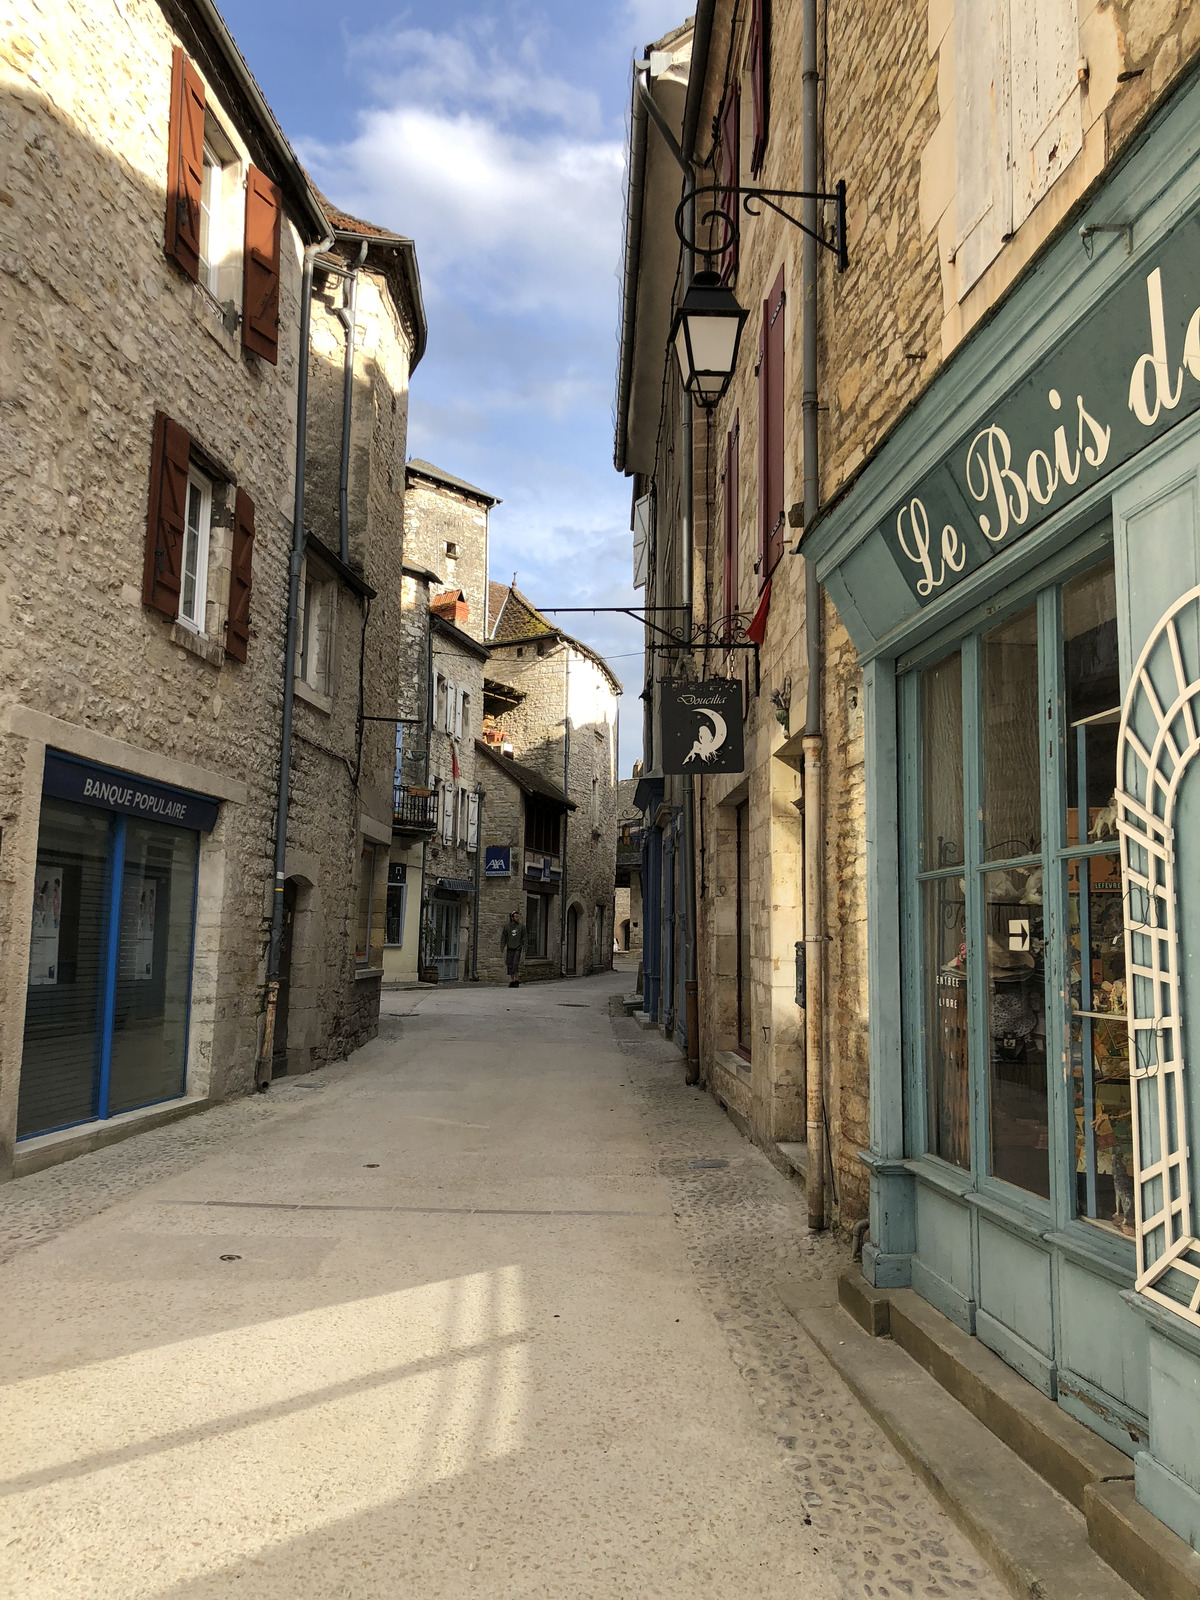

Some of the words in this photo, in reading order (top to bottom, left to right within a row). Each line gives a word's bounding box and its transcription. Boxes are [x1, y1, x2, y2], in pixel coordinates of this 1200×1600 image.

[896, 497, 966, 596] Le
[966, 388, 1111, 542] Bois
[83, 778, 134, 806] BANQUE
[132, 791, 187, 820] POPULAIRE
[486, 859, 506, 869] AXA
[938, 997, 958, 1009] LIBRE
